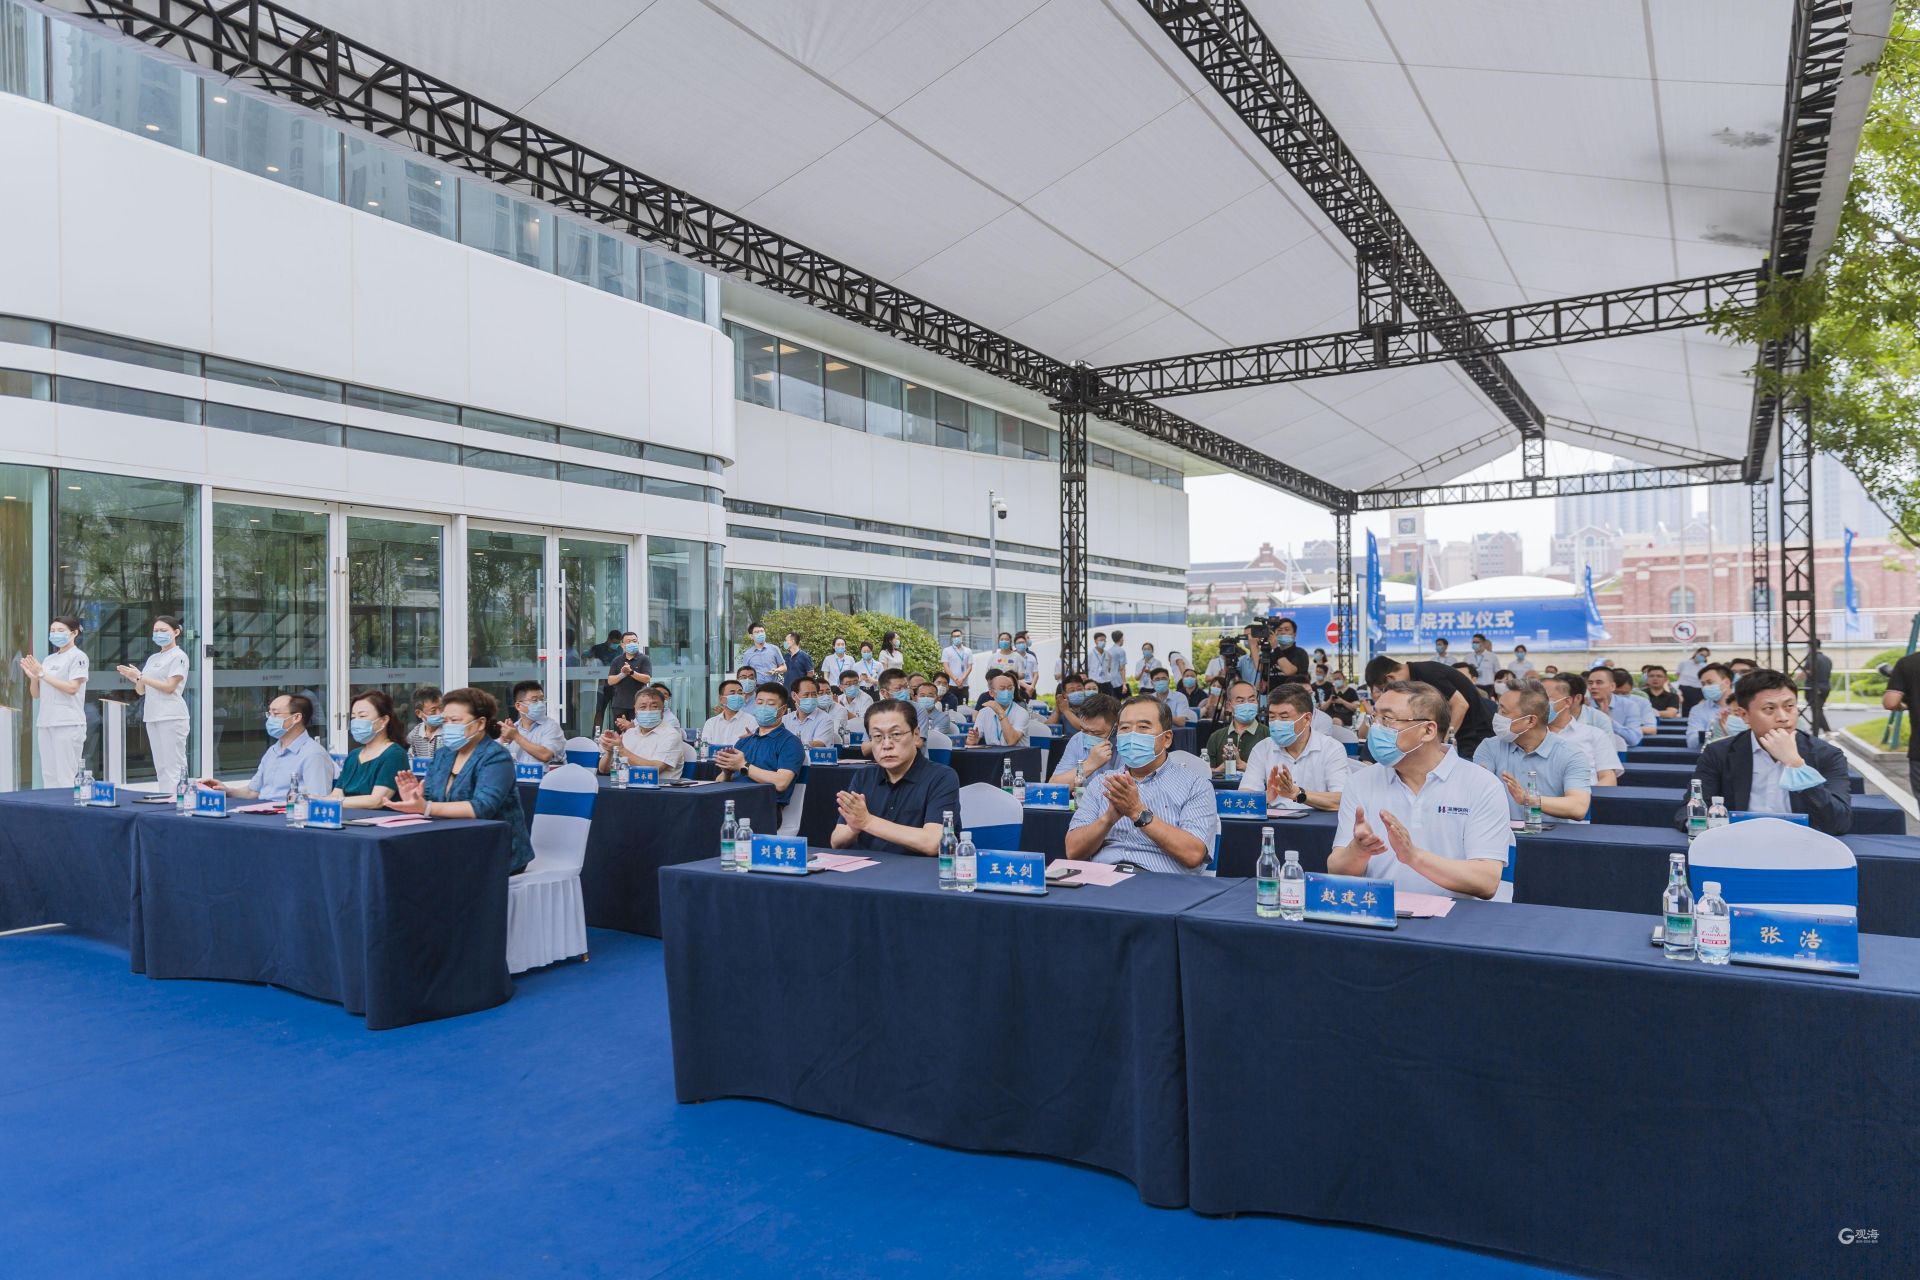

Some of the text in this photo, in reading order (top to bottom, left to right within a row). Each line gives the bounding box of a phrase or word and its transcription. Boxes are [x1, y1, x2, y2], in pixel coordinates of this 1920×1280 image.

[1223, 798, 1257, 809] 付元庆
[760, 845, 796, 860] 刘鲁强
[989, 862, 1032, 878] 王本剑
[1321, 887, 1377, 908] 赵建华
[1760, 926, 1822, 949] 张浩
